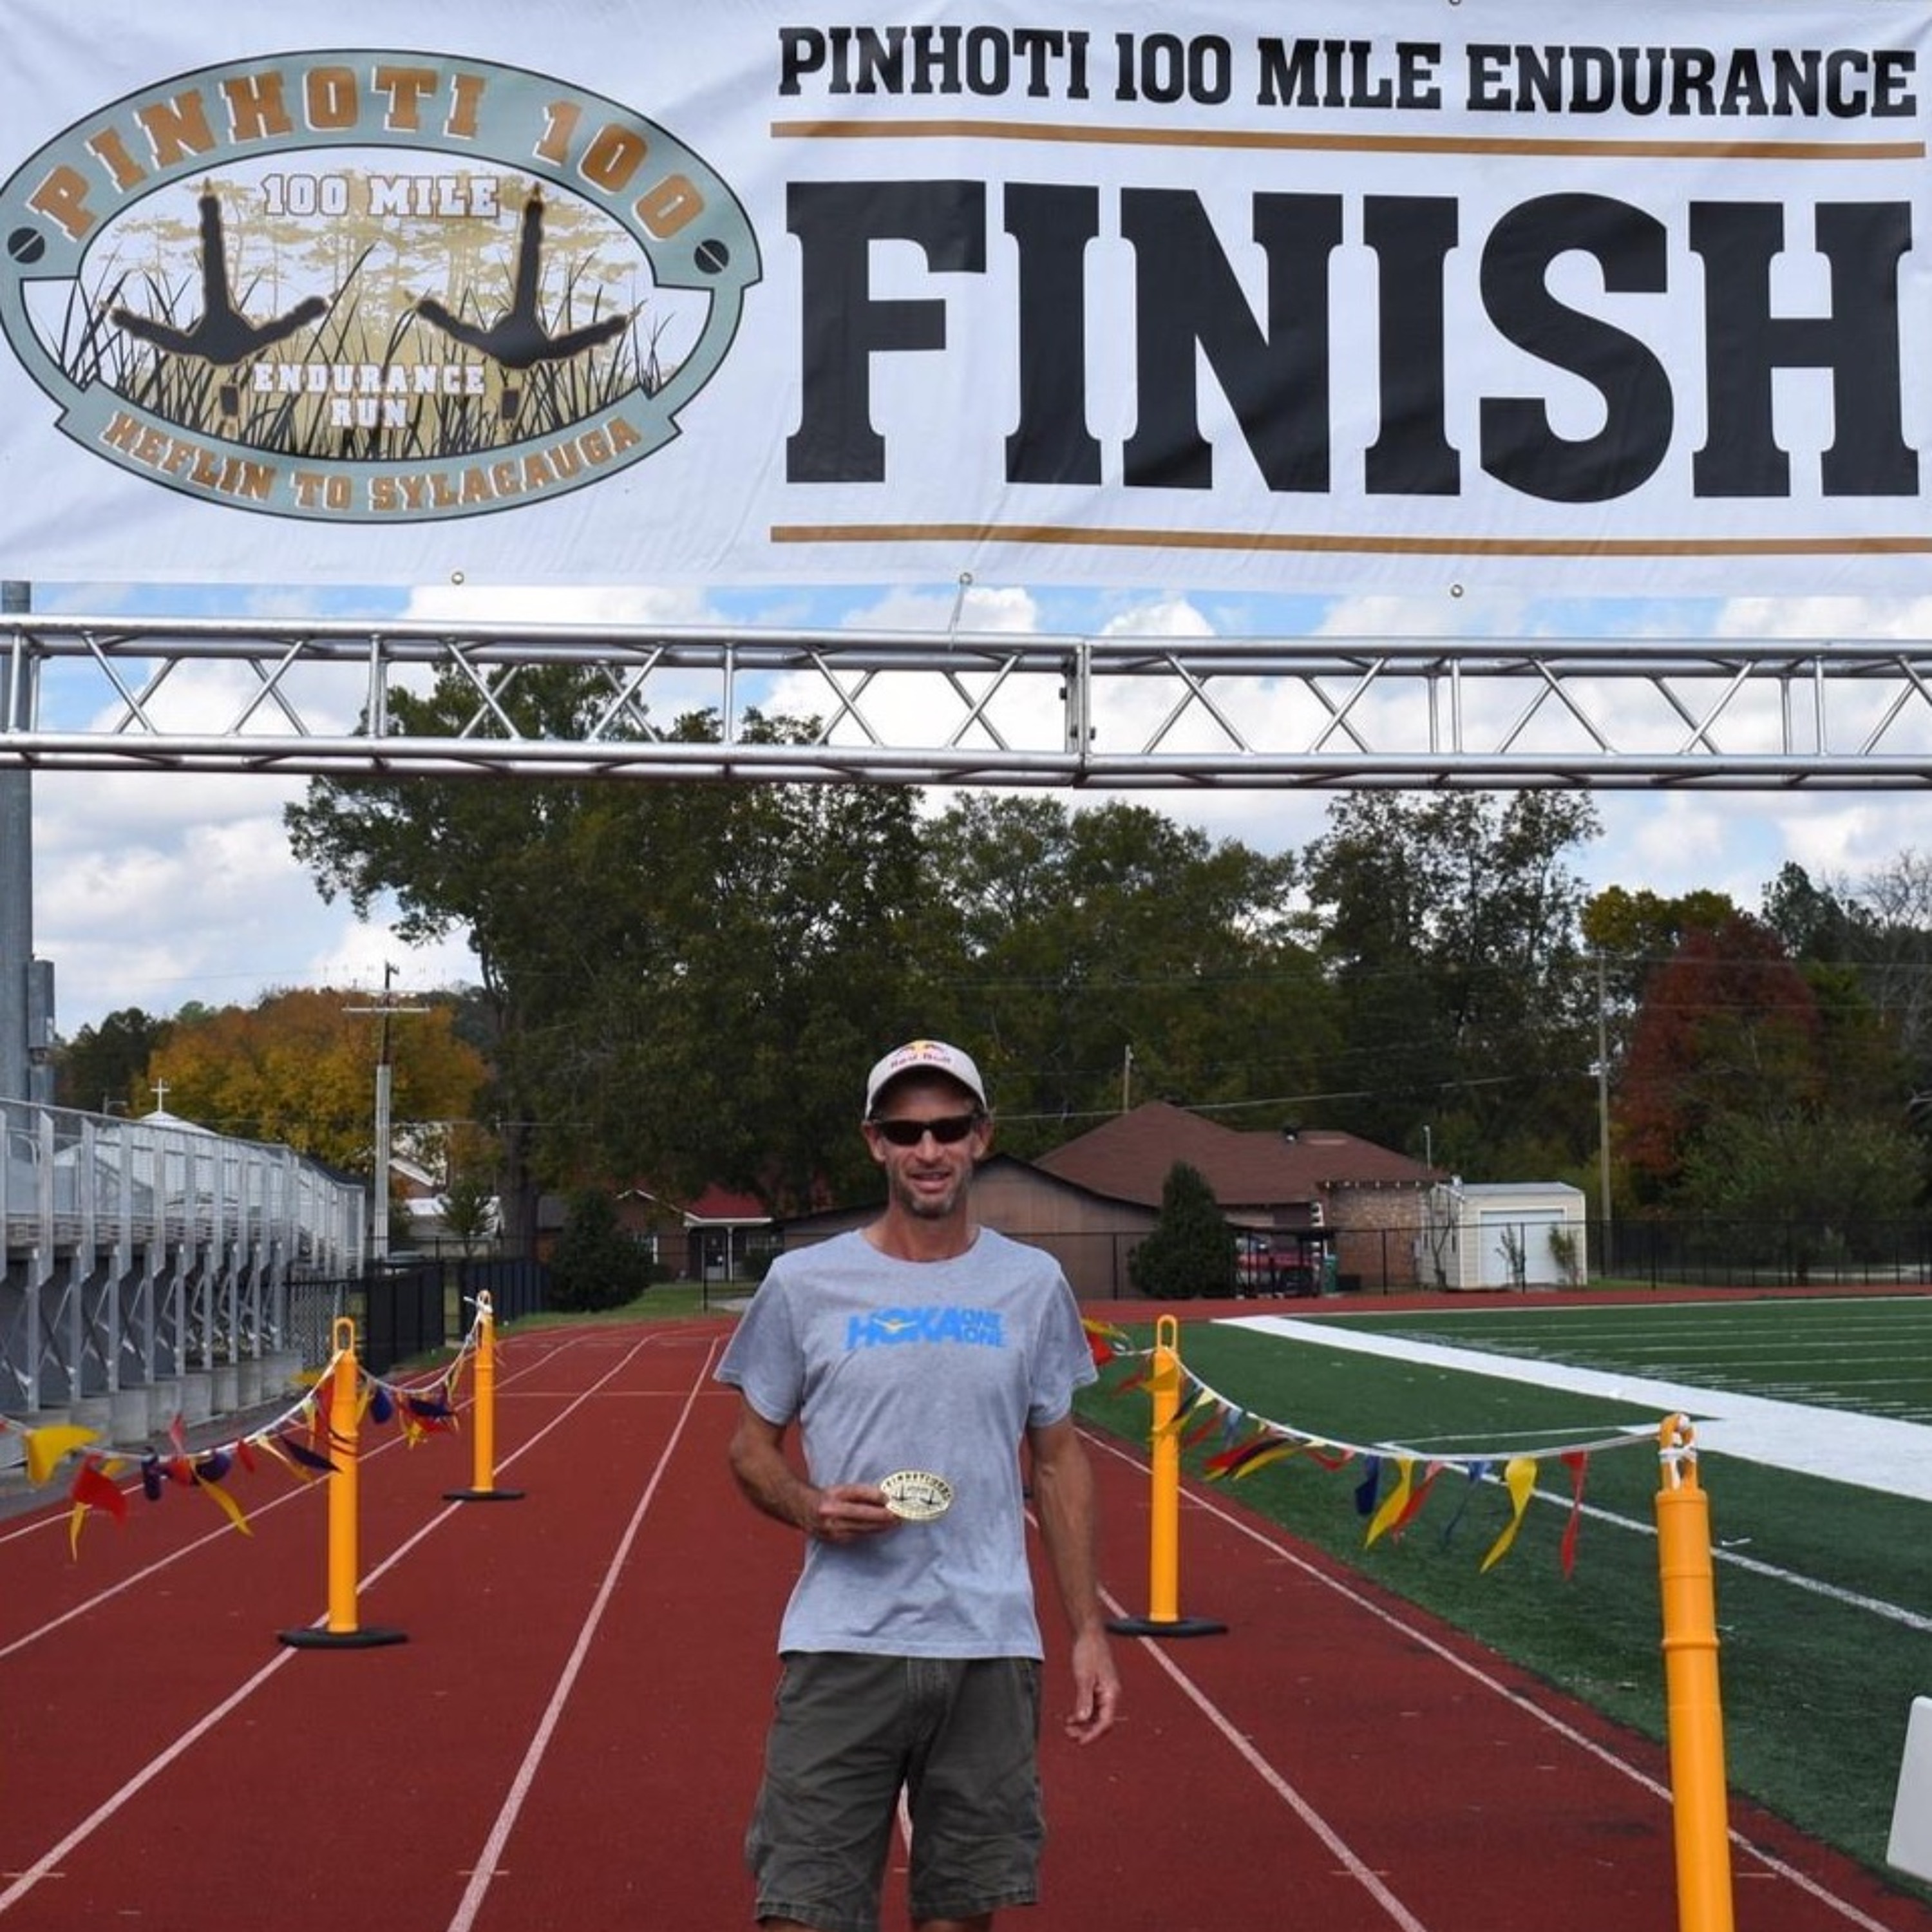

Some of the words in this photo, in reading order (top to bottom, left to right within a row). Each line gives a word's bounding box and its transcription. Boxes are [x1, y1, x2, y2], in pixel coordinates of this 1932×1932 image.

[778, 26, 1090, 100] PINHOTI
[1115, 33, 1231, 105] 100
[1258, 37, 1441, 109] MILE
[1466, 43, 1917, 118] ENDURANCE
[29, 65, 487, 242] PINHOTI
[531, 100, 706, 241] 100
[261, 173, 349, 216] 100
[367, 175, 500, 218] MILE
[785, 179, 1920, 504] FINISH
[253, 363, 486, 394] ENDURANCE
[330, 397, 408, 428] RUN
[99, 410, 277, 503] HEFLIN
[290, 469, 352, 511] TO
[368, 415, 643, 512] SYLACAUGA
[845, 1306, 963, 1350] HOKA
